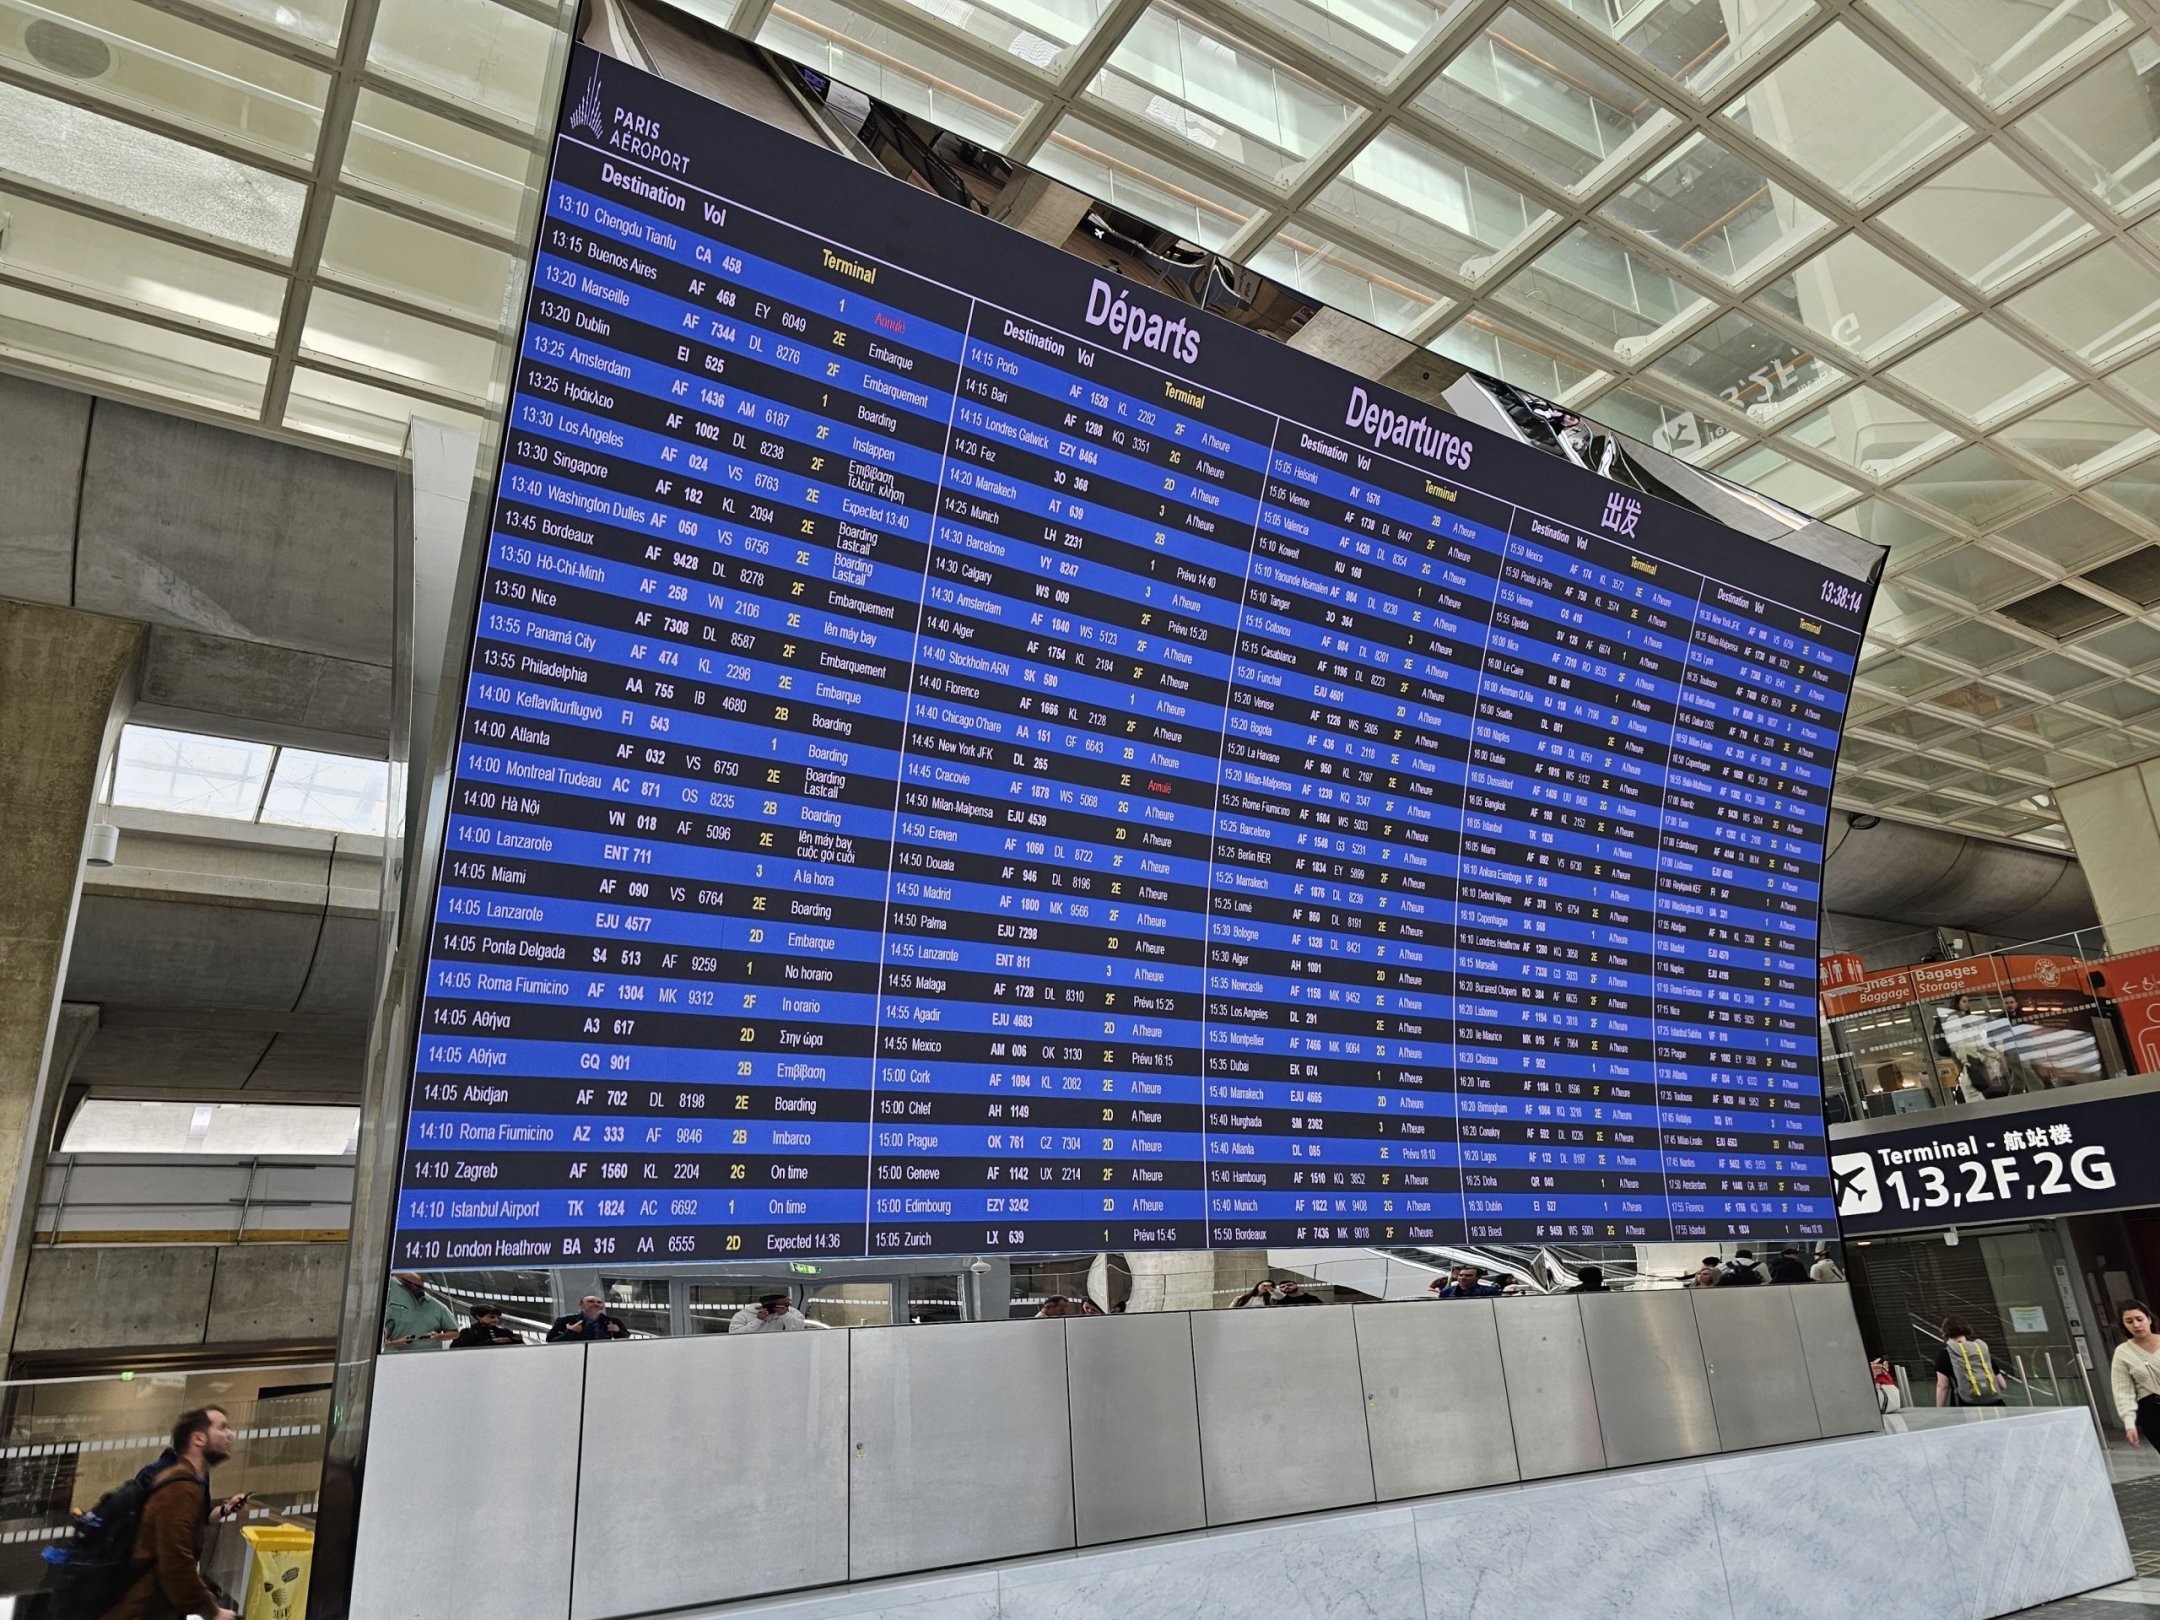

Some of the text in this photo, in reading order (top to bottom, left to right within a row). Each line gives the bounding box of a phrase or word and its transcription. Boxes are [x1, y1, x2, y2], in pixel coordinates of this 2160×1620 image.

[614, 107, 660, 139] PARIS
[610, 130, 690, 173] AÉROPORT
[602, 163, 876, 284] Destination Vol Terminal
[559, 194, 589, 218] 13:10
[594, 207, 643, 238] Chengdu
[645, 225, 677, 251] Tianfu
[695, 245, 712, 264] CA
[722, 255, 742, 274] 458
[839, 298, 845, 312] 1
[553, 230, 913, 370] 13:15 Buenos Aires AF 468 EY 6049 2E Embarque
[1086, 278, 1200, 363] Départs
[1004, 320, 1205, 409] Destination Vol Terminal
[535, 335, 895, 462] 13:25 Amsterdam AF 1436 AM 6187 2F Instappen
[1346, 387, 1472, 470] Departures
[1301, 434, 1457, 502] Destination Vol Terminal
[1601, 492, 1641, 538] 出发
[506, 510, 895, 619] 13:45 Bordeaux AF 9428 DL 8278 2F Embarquement
[945, 497, 1217, 589] 14:25 Munich LH 2231 1 Prévu 14:40
[1532, 520, 1657, 575] Destination Vol Terminal
[1718, 588, 1821, 634] Destination Vol Terminal
[1821, 580, 1862, 612] 13:38:14
[484, 649, 852, 736] 13:55 Philadelphia AA 755 IB 4680 2B Boarding
[912, 733, 935, 749] 14:45
[938, 738, 957, 753] New
[958, 742, 976, 757] York
[976, 746, 994, 760] JFK
[1013, 752, 1025, 767] DL
[1033, 756, 1048, 770] 265
[1120, 773, 1131, 787] 2E
[459, 825, 491, 844] 14:00
[496, 830, 553, 852] Lanzarote
[603, 844, 630, 861] ENT
[633, 848, 652, 864] 711
[755, 863, 763, 878] 3
[802, 870, 812, 884] la
[813, 871, 835, 887] hora
[443, 934, 833, 981] 14:05 Ponta Delgada S4 513 AF 9259 1 No horario
[1898, 966, 1977, 984] à Bagages
[1860, 980, 1964, 1003] Baggage Storage
[434, 1008, 823, 1048] 14:05 Αθήνα A3 617 2D Στην ώρα
[415, 1161, 808, 1182] 14:10 Zagreb AF 1560 KL 2204 2G On time
[1878, 1136, 1978, 1166] Terminal
[2004, 1124, 2072, 1151] 航站楼
[405, 1233, 841, 1258] 14:10 London Heathrow BA 315 AA 6555 2D Expected 14:36
[875, 1228, 1177, 1247] 15:05 Zurich LX 639 1 Prévu 15:45
